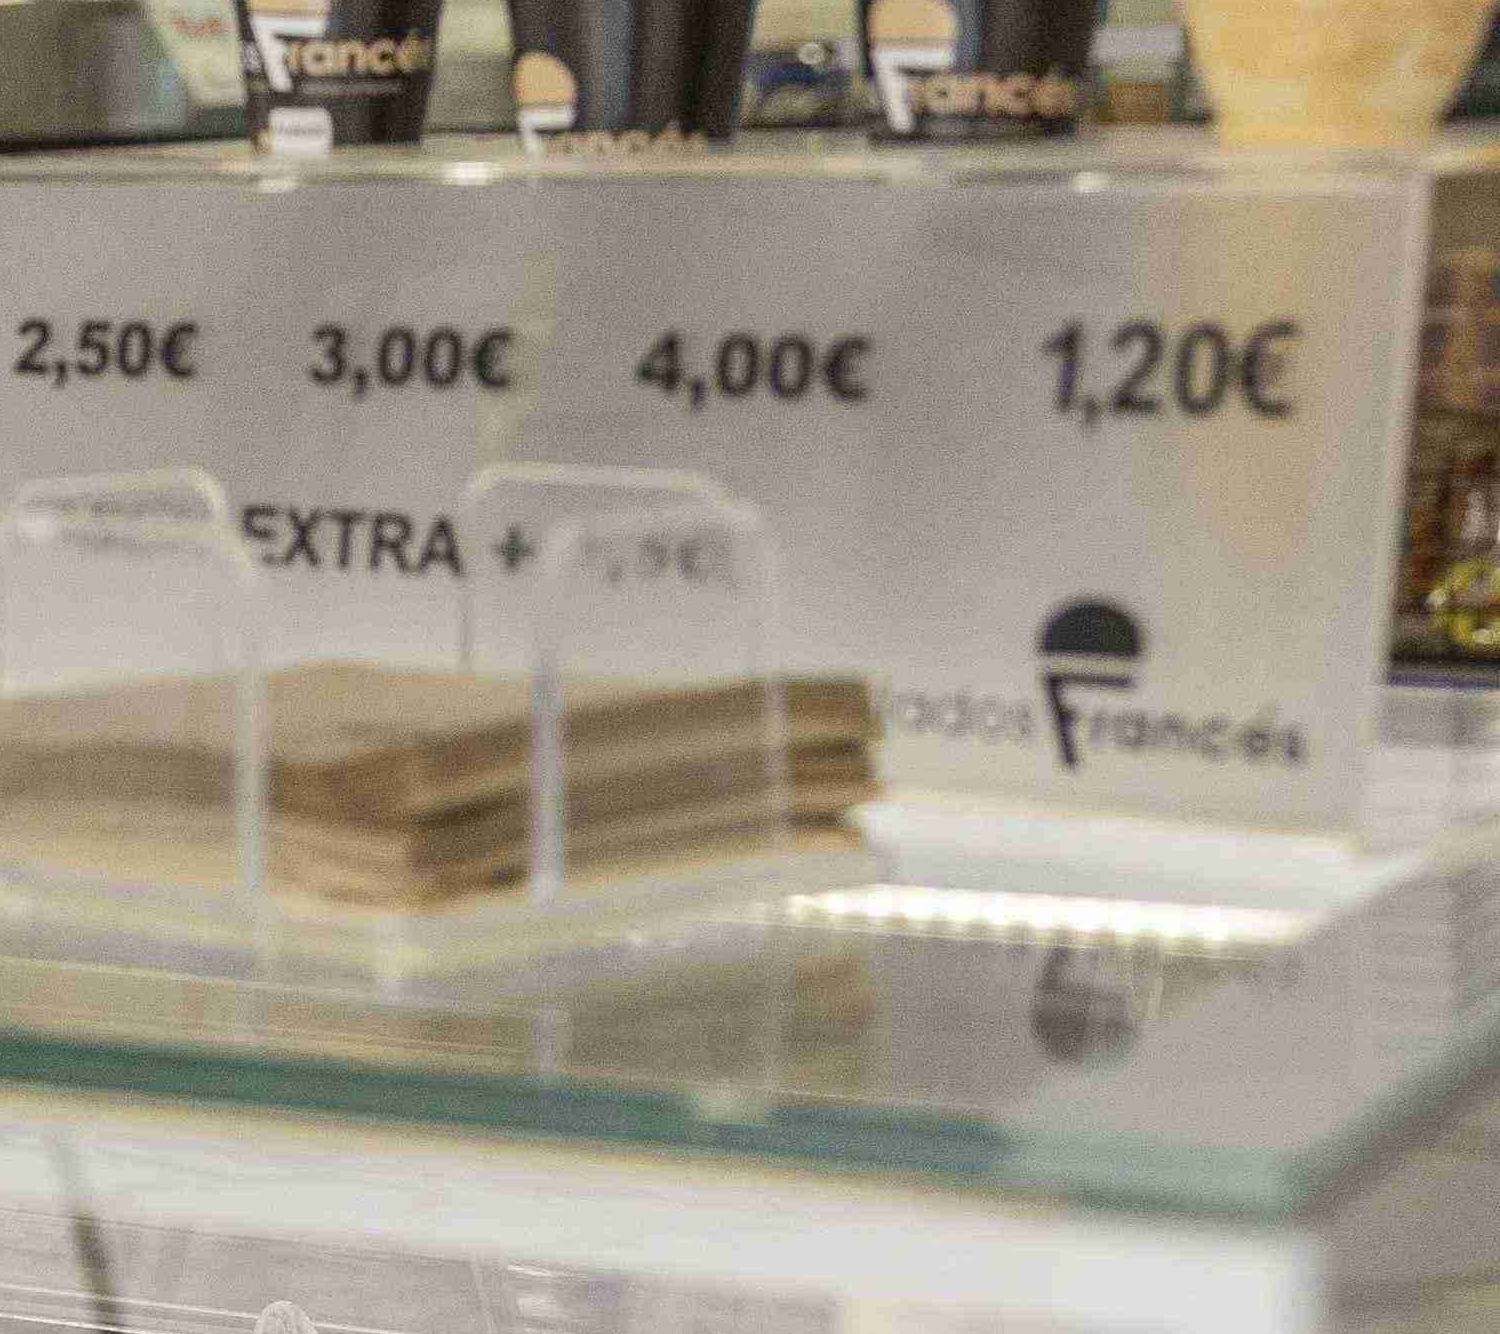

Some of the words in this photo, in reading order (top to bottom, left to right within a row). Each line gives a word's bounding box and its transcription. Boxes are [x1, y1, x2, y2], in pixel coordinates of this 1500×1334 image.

[13, 317, 201, 389] 2,50€
[307, 322, 516, 399] 3,00€
[636, 331, 874, 410] 4,00€
[1041, 318, 1304, 425] 1,20€
[240, 502, 467, 578] EXTRA
